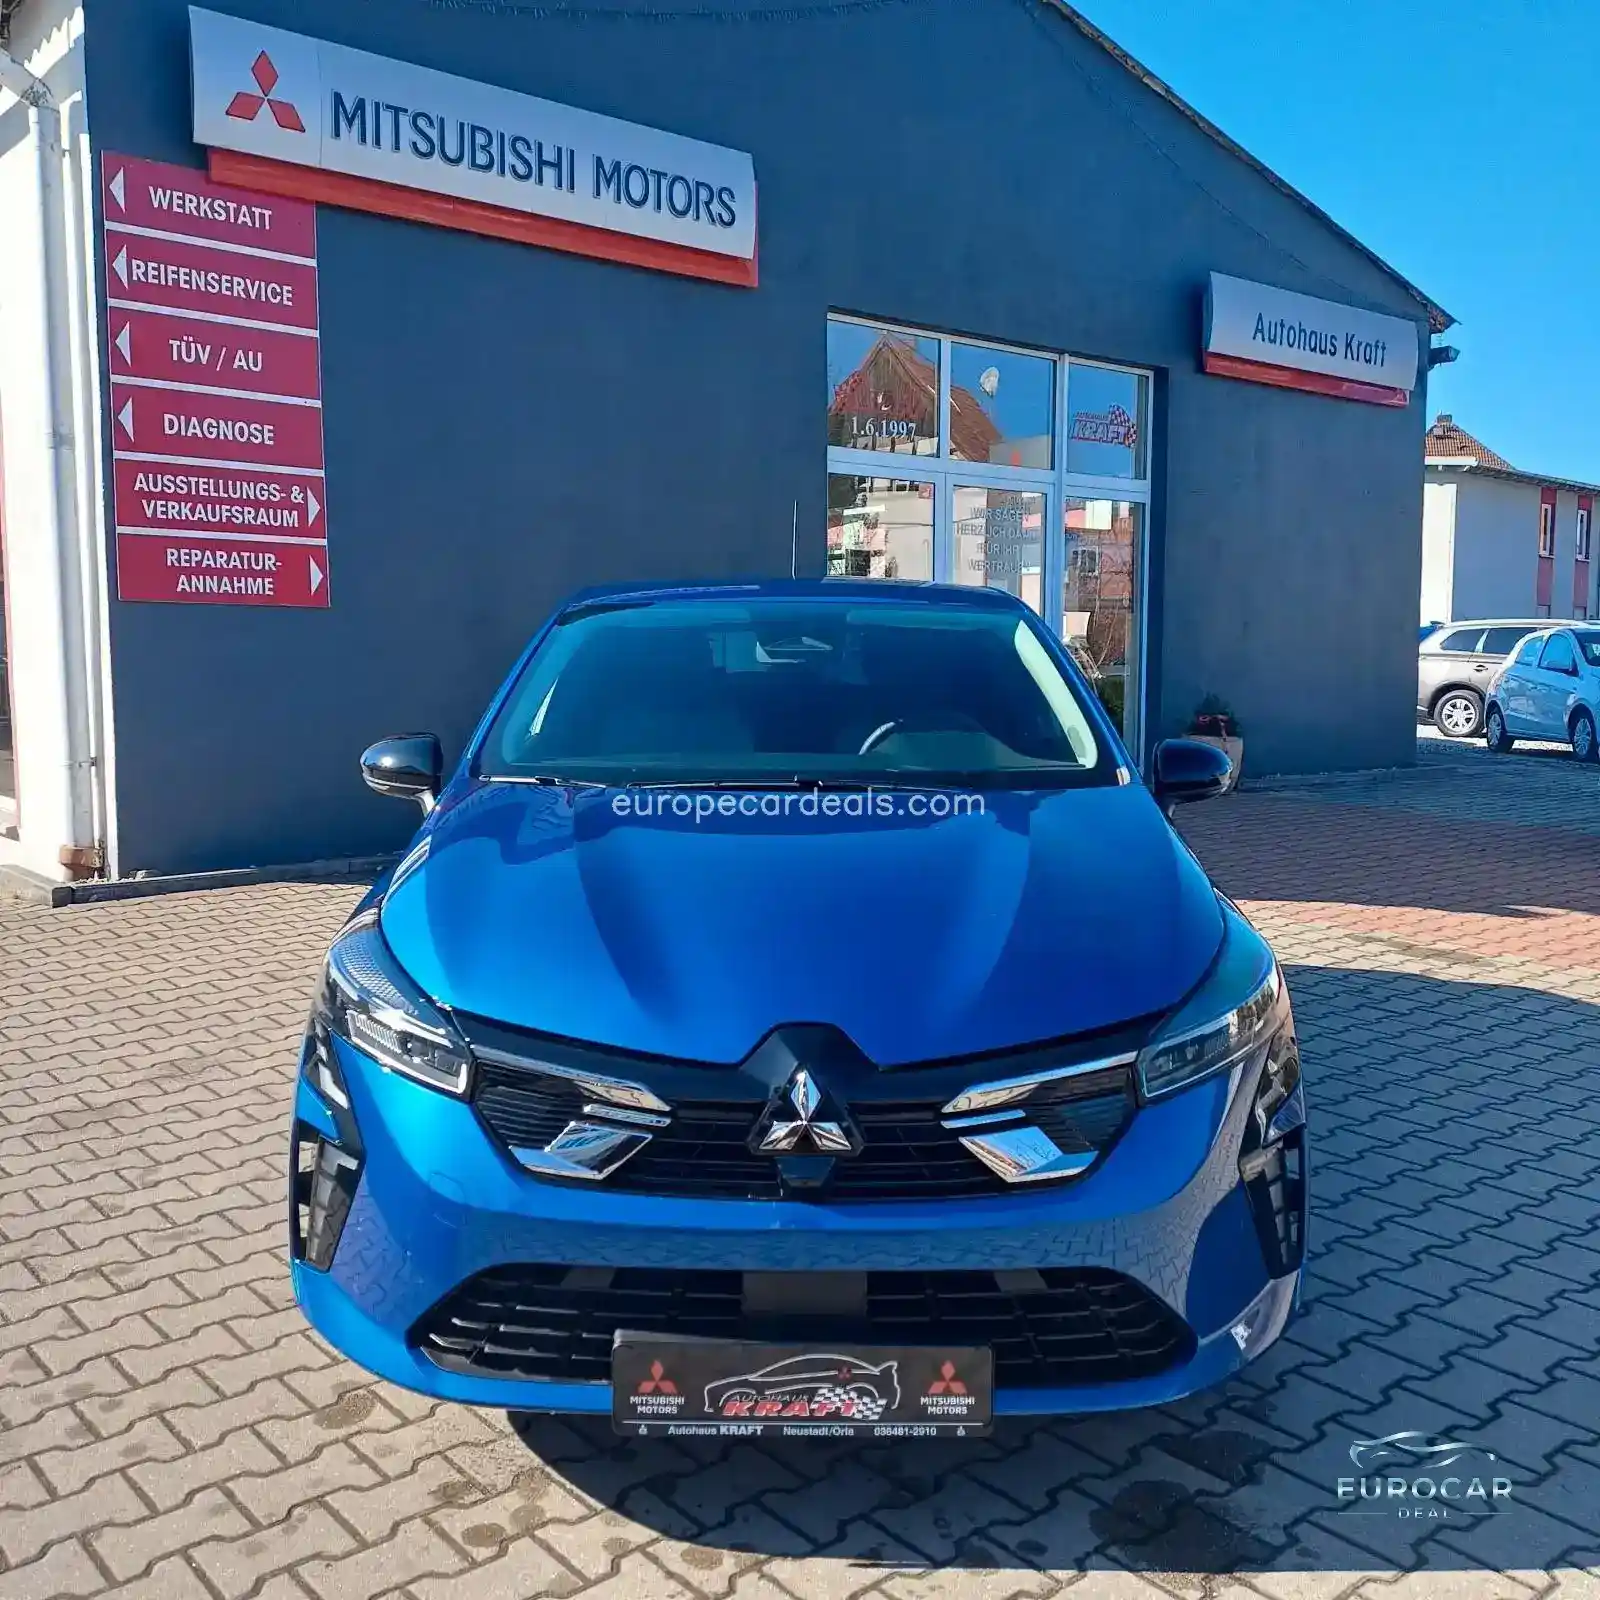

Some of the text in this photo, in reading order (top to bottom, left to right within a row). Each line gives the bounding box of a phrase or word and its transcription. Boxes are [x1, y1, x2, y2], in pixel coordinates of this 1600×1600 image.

[331, 90, 737, 228] MITSUBISHI MOTORS
[148, 186, 272, 230] WERKSTATT
[131, 258, 293, 306] REIFENSERVICE
[1252, 312, 1387, 367] Autohaus Kraft
[169, 335, 211, 365] TÜV
[233, 350, 263, 372] AU
[163, 413, 274, 445] DIAGNOSE
[851, 416, 917, 440] 1.6.1997
[134, 472, 304, 504] AUSSTELLUNGS- &
[142, 499, 299, 528] VERKAUFSRAUM
[167, 548, 282, 572] REPARATUR-
[176, 574, 274, 596] ANNAHME
[629, 1395, 686, 1405] MITSUBISHI
[636, 1405, 678, 1415] MOTORS
[721, 1401, 860, 1418] KRAFT
[919, 1396, 976, 1406] MITSUBISHI
[926, 1405, 969, 1416] MOTORS
[667, 1425, 718, 1436] Autohaus
[719, 1425, 764, 1436] KRAFT
